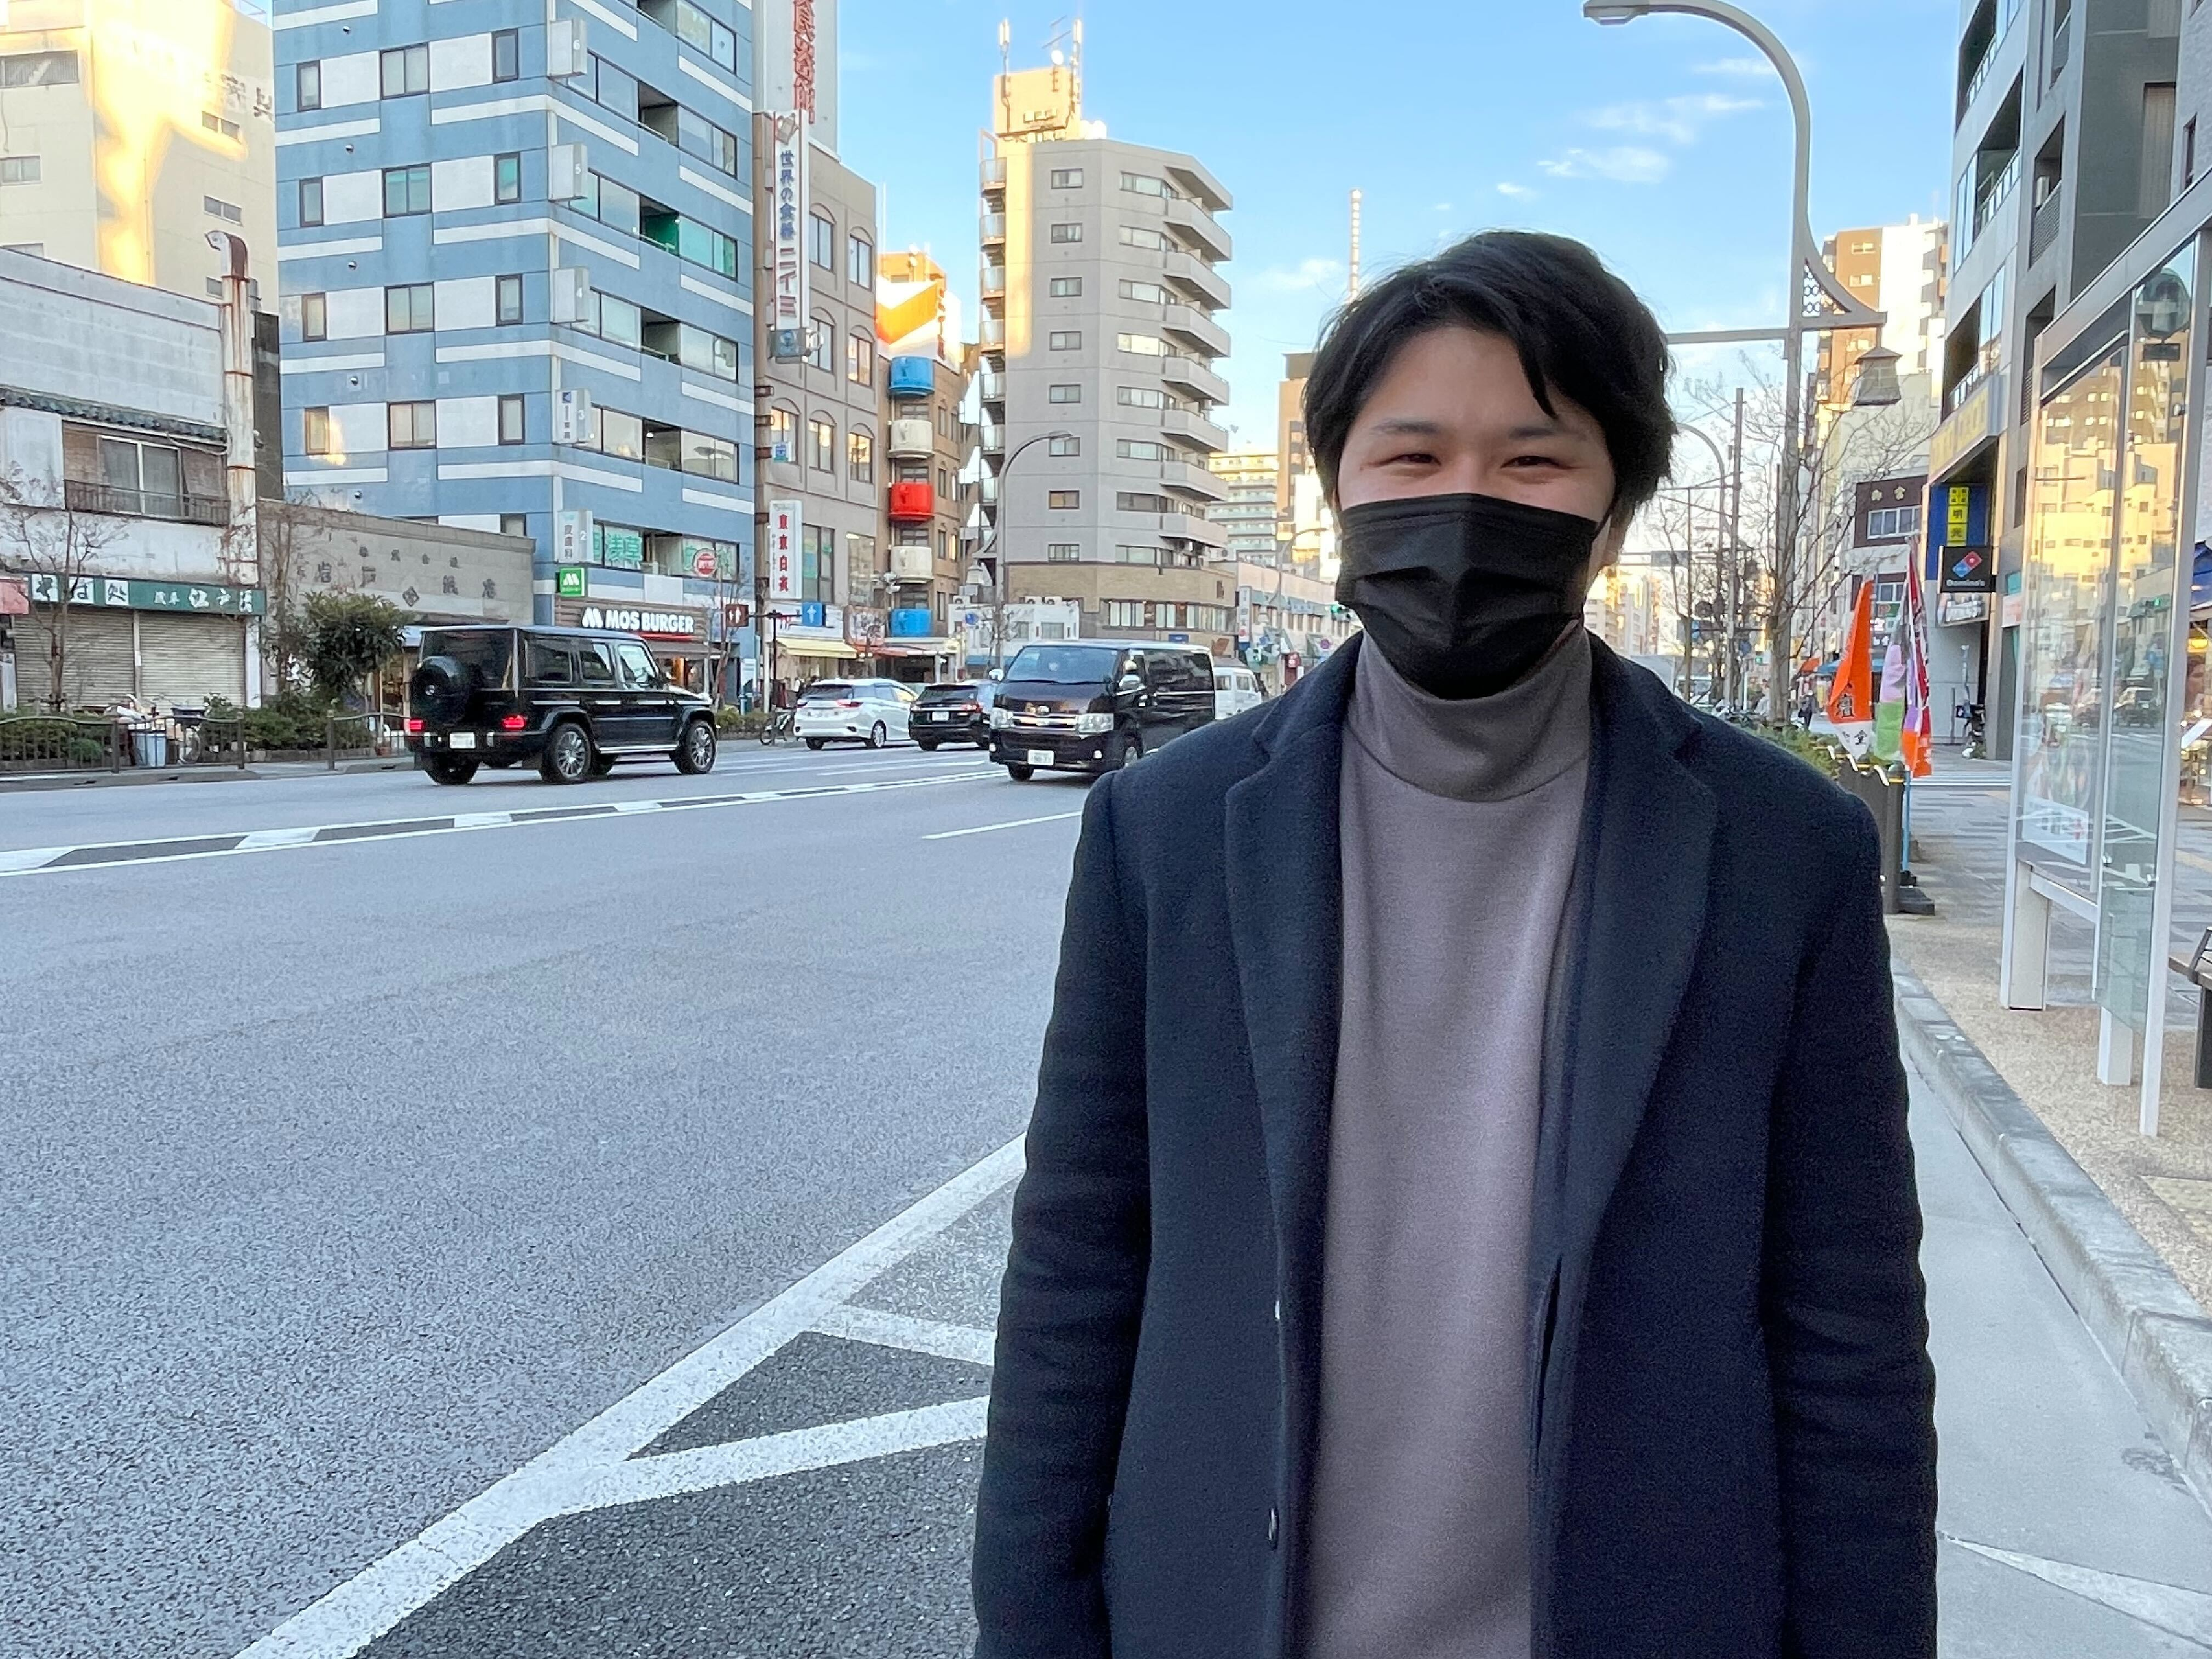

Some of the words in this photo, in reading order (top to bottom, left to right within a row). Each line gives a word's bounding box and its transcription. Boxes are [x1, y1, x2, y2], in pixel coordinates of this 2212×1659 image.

[573, 40, 580, 51] 6
[575, 163, 581, 174] 5
[780, 150, 796, 240] 世界の食器
[779, 248, 796, 317] ニイミ
[576, 287, 583, 298] 4
[578, 410, 585, 420] 3
[580, 531, 587, 541] 2
[605, 610, 640, 631] MOS
[641, 612, 693, 633] BURGER
